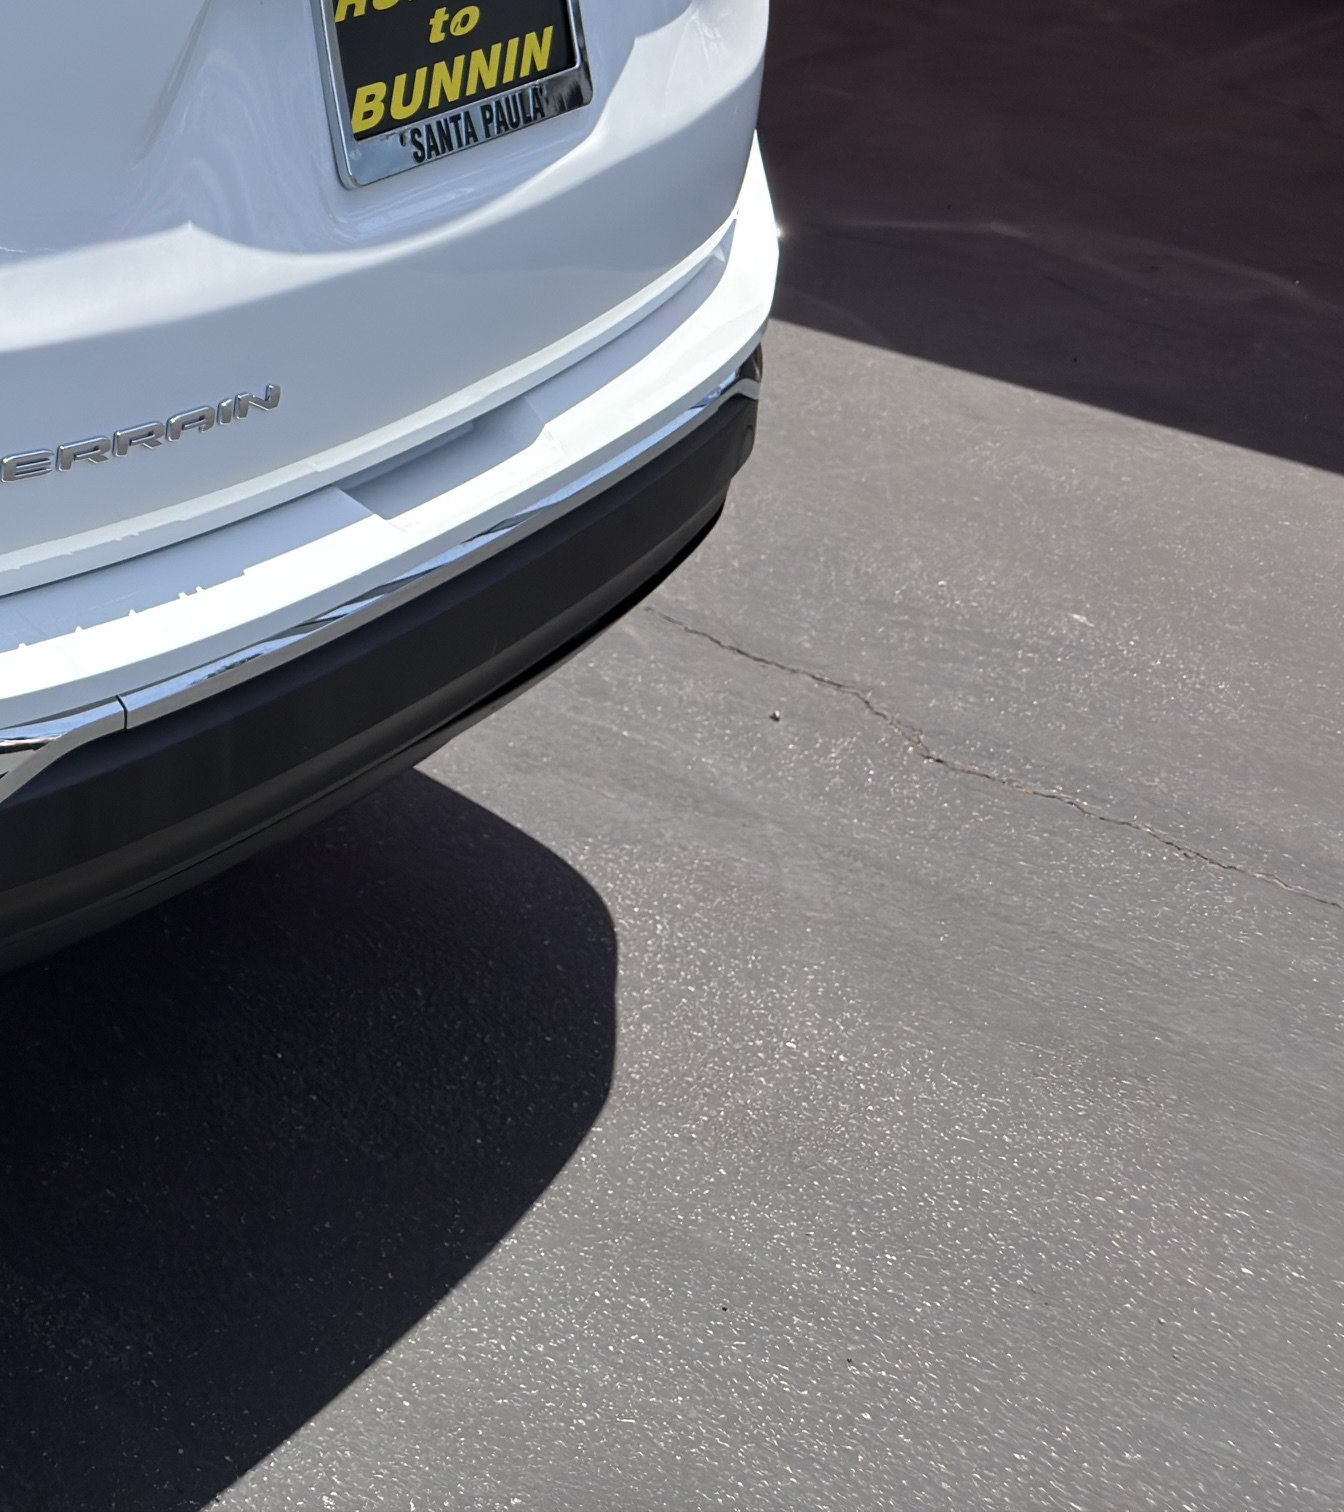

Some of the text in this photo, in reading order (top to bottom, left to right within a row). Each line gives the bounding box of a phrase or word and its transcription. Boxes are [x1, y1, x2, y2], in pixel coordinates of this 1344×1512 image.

[428, 4, 481, 44] to
[350, 24, 555, 135] BUNNIN
[411, 86, 546, 163] SANTA PAULA
